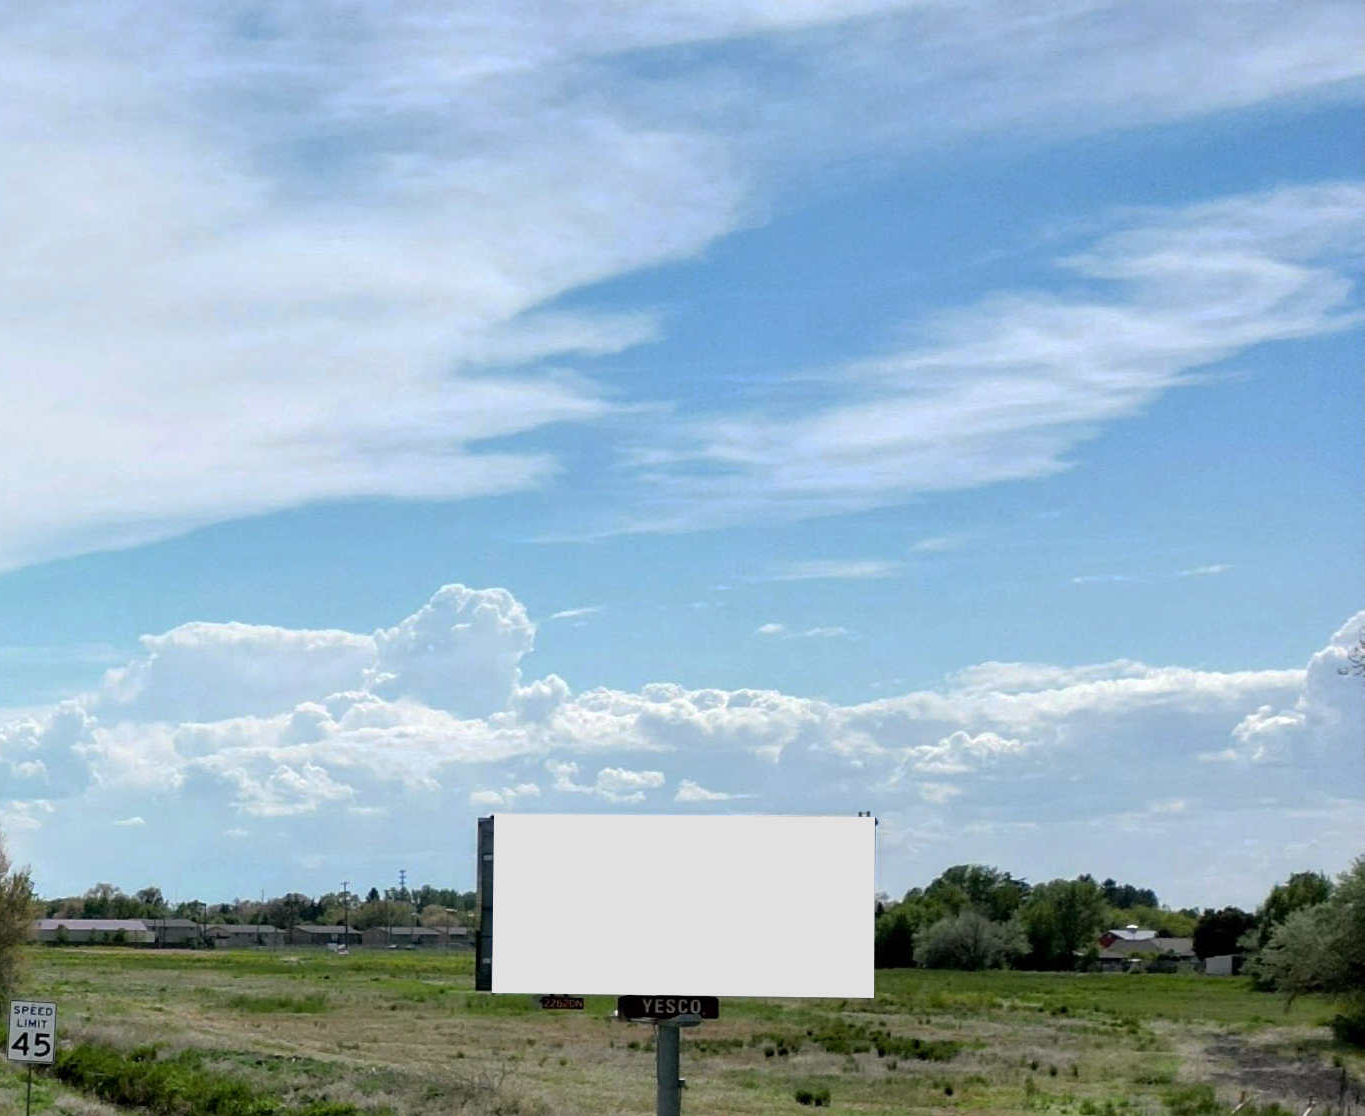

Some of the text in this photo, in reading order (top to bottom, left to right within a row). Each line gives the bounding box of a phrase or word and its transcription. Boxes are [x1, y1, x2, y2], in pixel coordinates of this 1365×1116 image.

[14, 1005, 53, 1016] SPEED
[642, 998, 702, 1014] YESCO
[16, 1019, 47, 1028] LIMIT
[11, 1032, 51, 1057] 45
